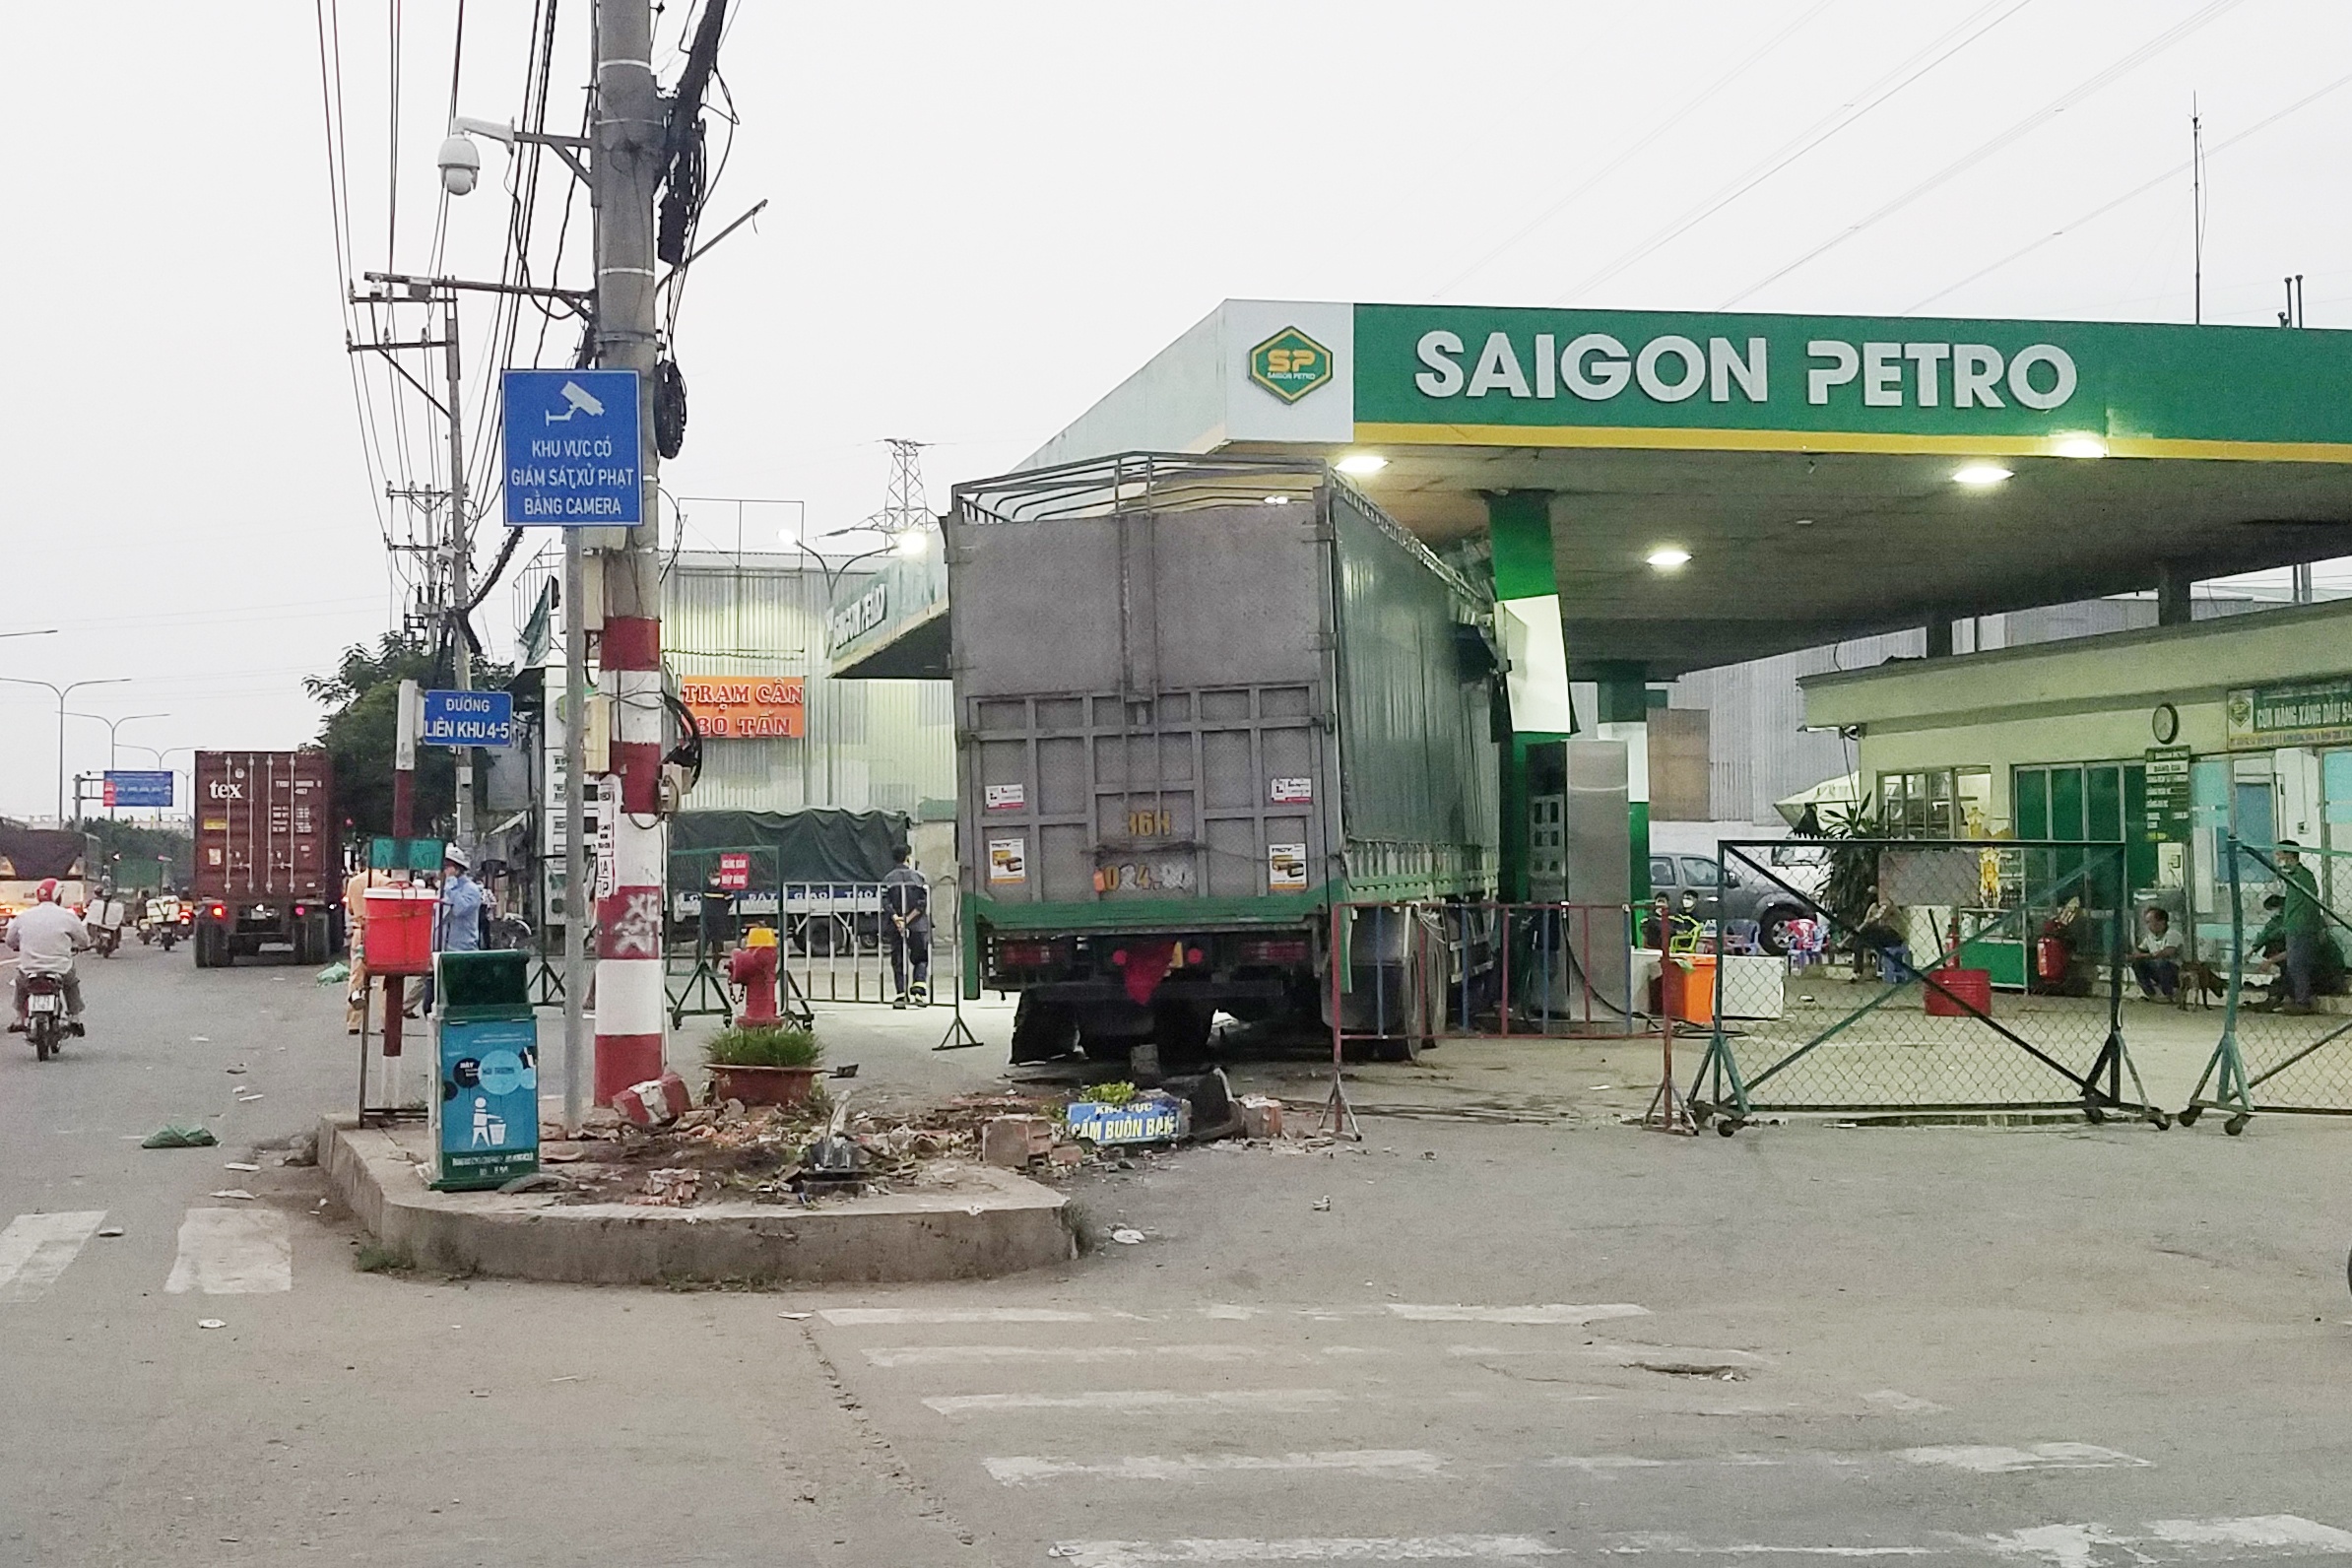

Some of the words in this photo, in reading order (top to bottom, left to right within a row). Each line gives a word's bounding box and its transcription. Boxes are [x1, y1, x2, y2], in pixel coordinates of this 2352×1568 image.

[1267, 349, 1316, 372] SP
[1414, 329, 1769, 402] SAIGON
[1806, 339, 2078, 411] PETRO
[532, 439, 559, 458] KHU
[563, 439, 591, 460] VỰC
[510, 465, 546, 486] GIÁM
[598, 468, 634, 490] PHẠT
[524, 490, 562, 515] BẰNG
[565, 496, 622, 515] CAMERA
[445, 694, 490, 712] ĐƯỜNG
[683, 684, 751, 710] TRẠM
[425, 716, 454, 738] LIÊN
[457, 721, 486, 738] KHU
[487, 722, 509, 739] 4-5
[737, 710, 792, 736] TẤN
[209, 779, 244, 799] tex
[1104, 1115, 1143, 1140] BUÔN
